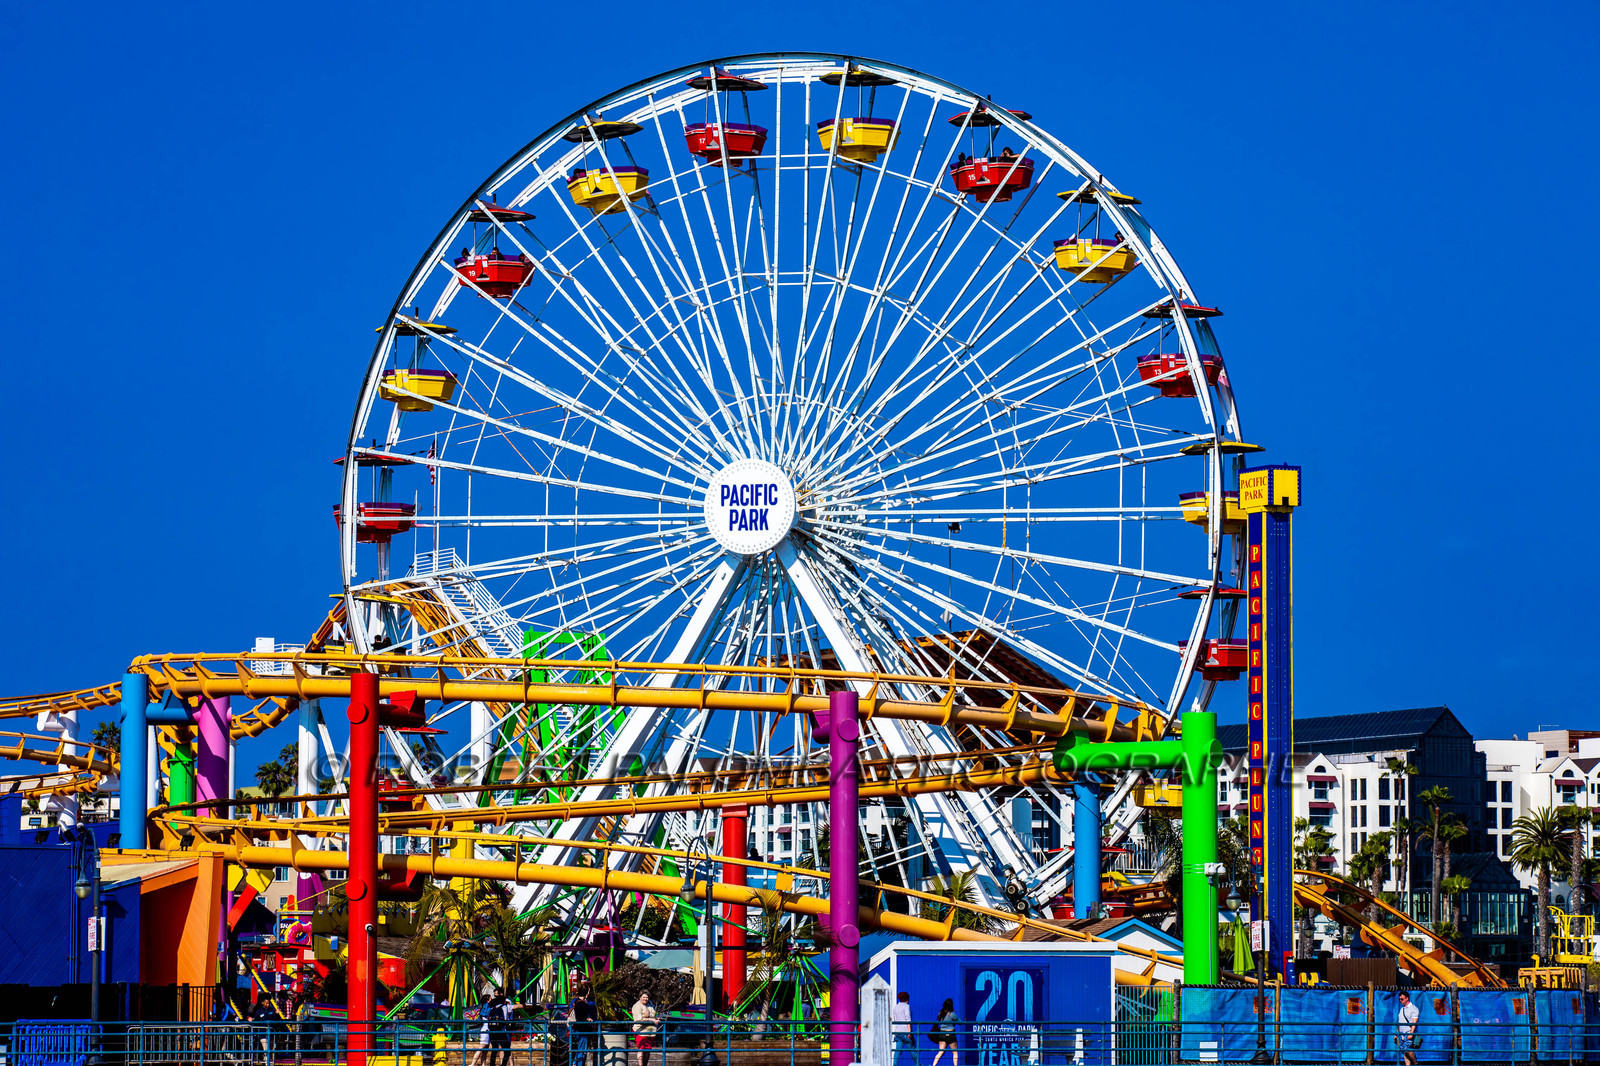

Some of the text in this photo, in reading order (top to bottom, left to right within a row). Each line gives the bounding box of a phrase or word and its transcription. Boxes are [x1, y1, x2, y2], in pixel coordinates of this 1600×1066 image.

[1240, 476, 1268, 489] PACIFIC
[720, 483, 778, 507] PACIFIC
[1244, 489, 1263, 501] PARK
[729, 508, 769, 532] PARK
[1251, 545, 1262, 719] PACIFIC
[975, 970, 1034, 1024] 20
